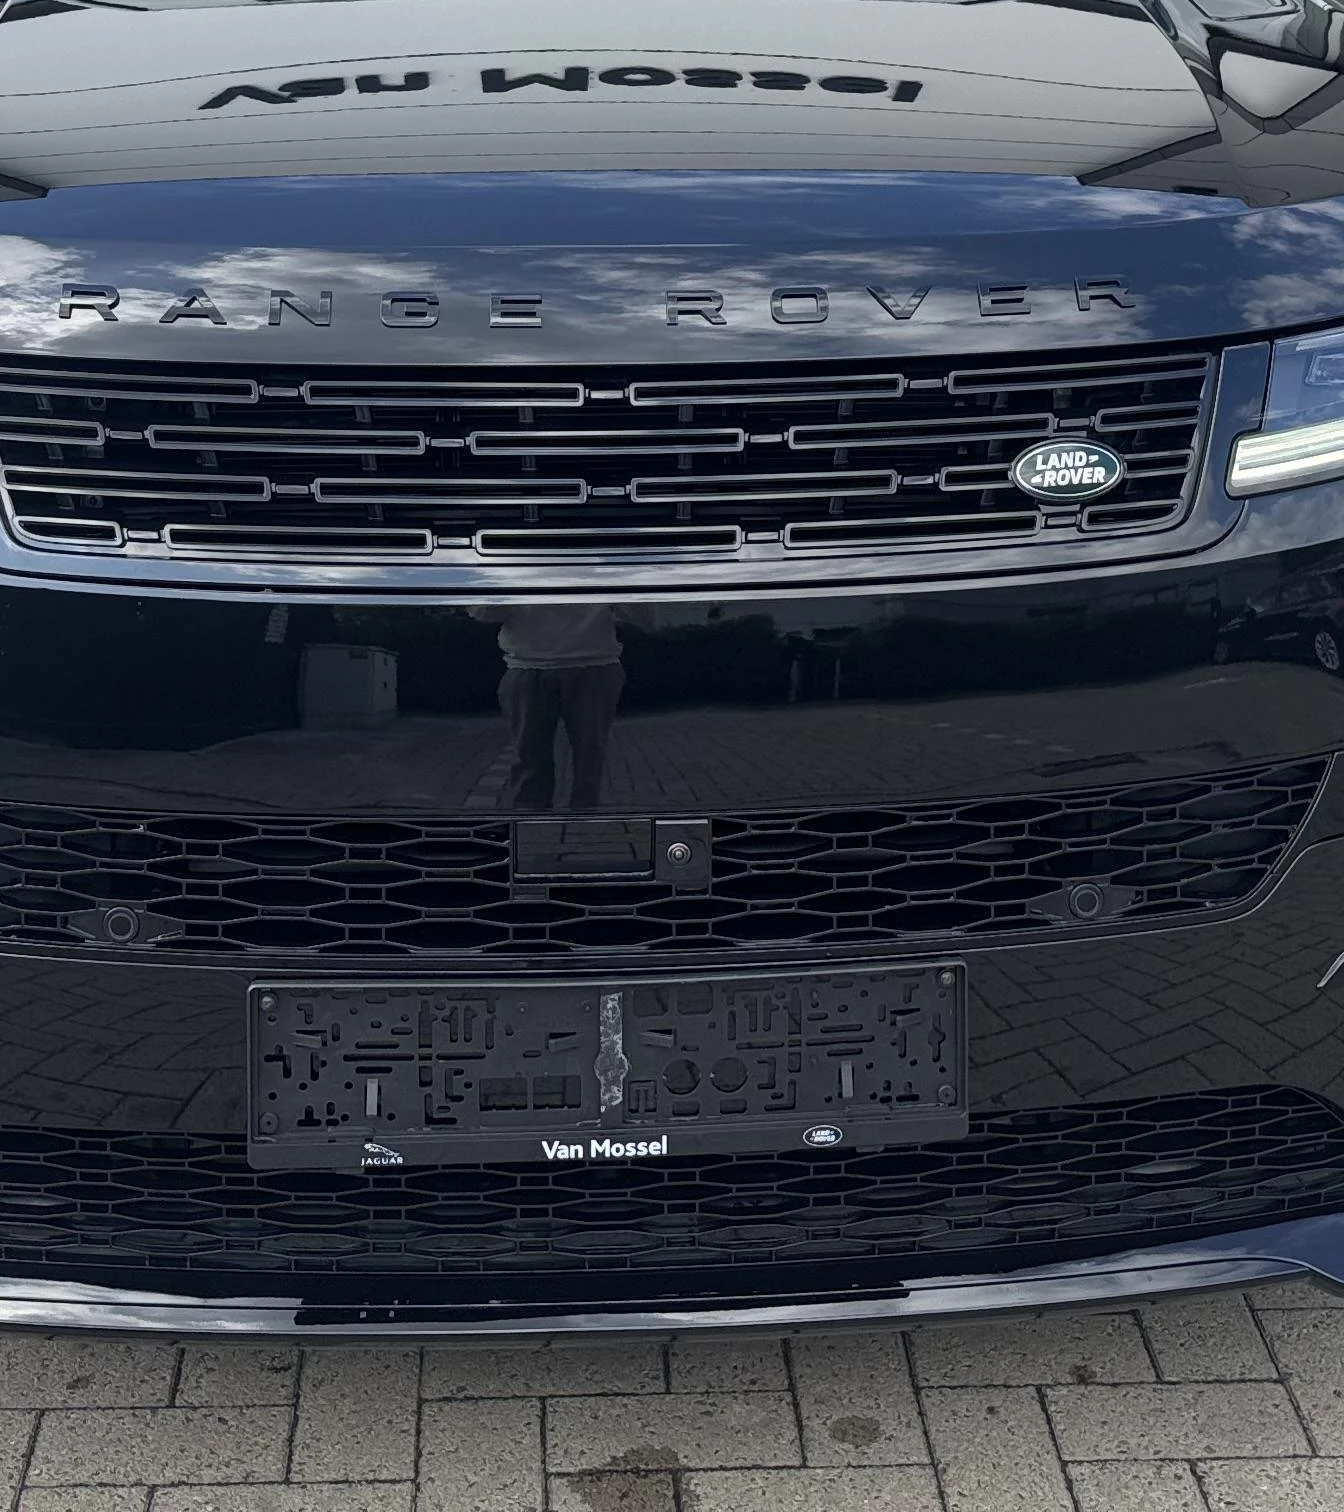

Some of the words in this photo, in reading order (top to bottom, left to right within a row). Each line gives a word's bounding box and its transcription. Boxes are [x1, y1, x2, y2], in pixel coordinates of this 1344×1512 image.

[57, 280, 543, 328] RANGE
[665, 274, 1137, 327] ROVER
[1035, 451, 1087, 471] LAND
[1043, 466, 1105, 487] ROVER
[542, 1140, 584, 1160] Van
[590, 1135, 668, 1159] Mossel
[360, 1156, 404, 1167] JAGUAR
